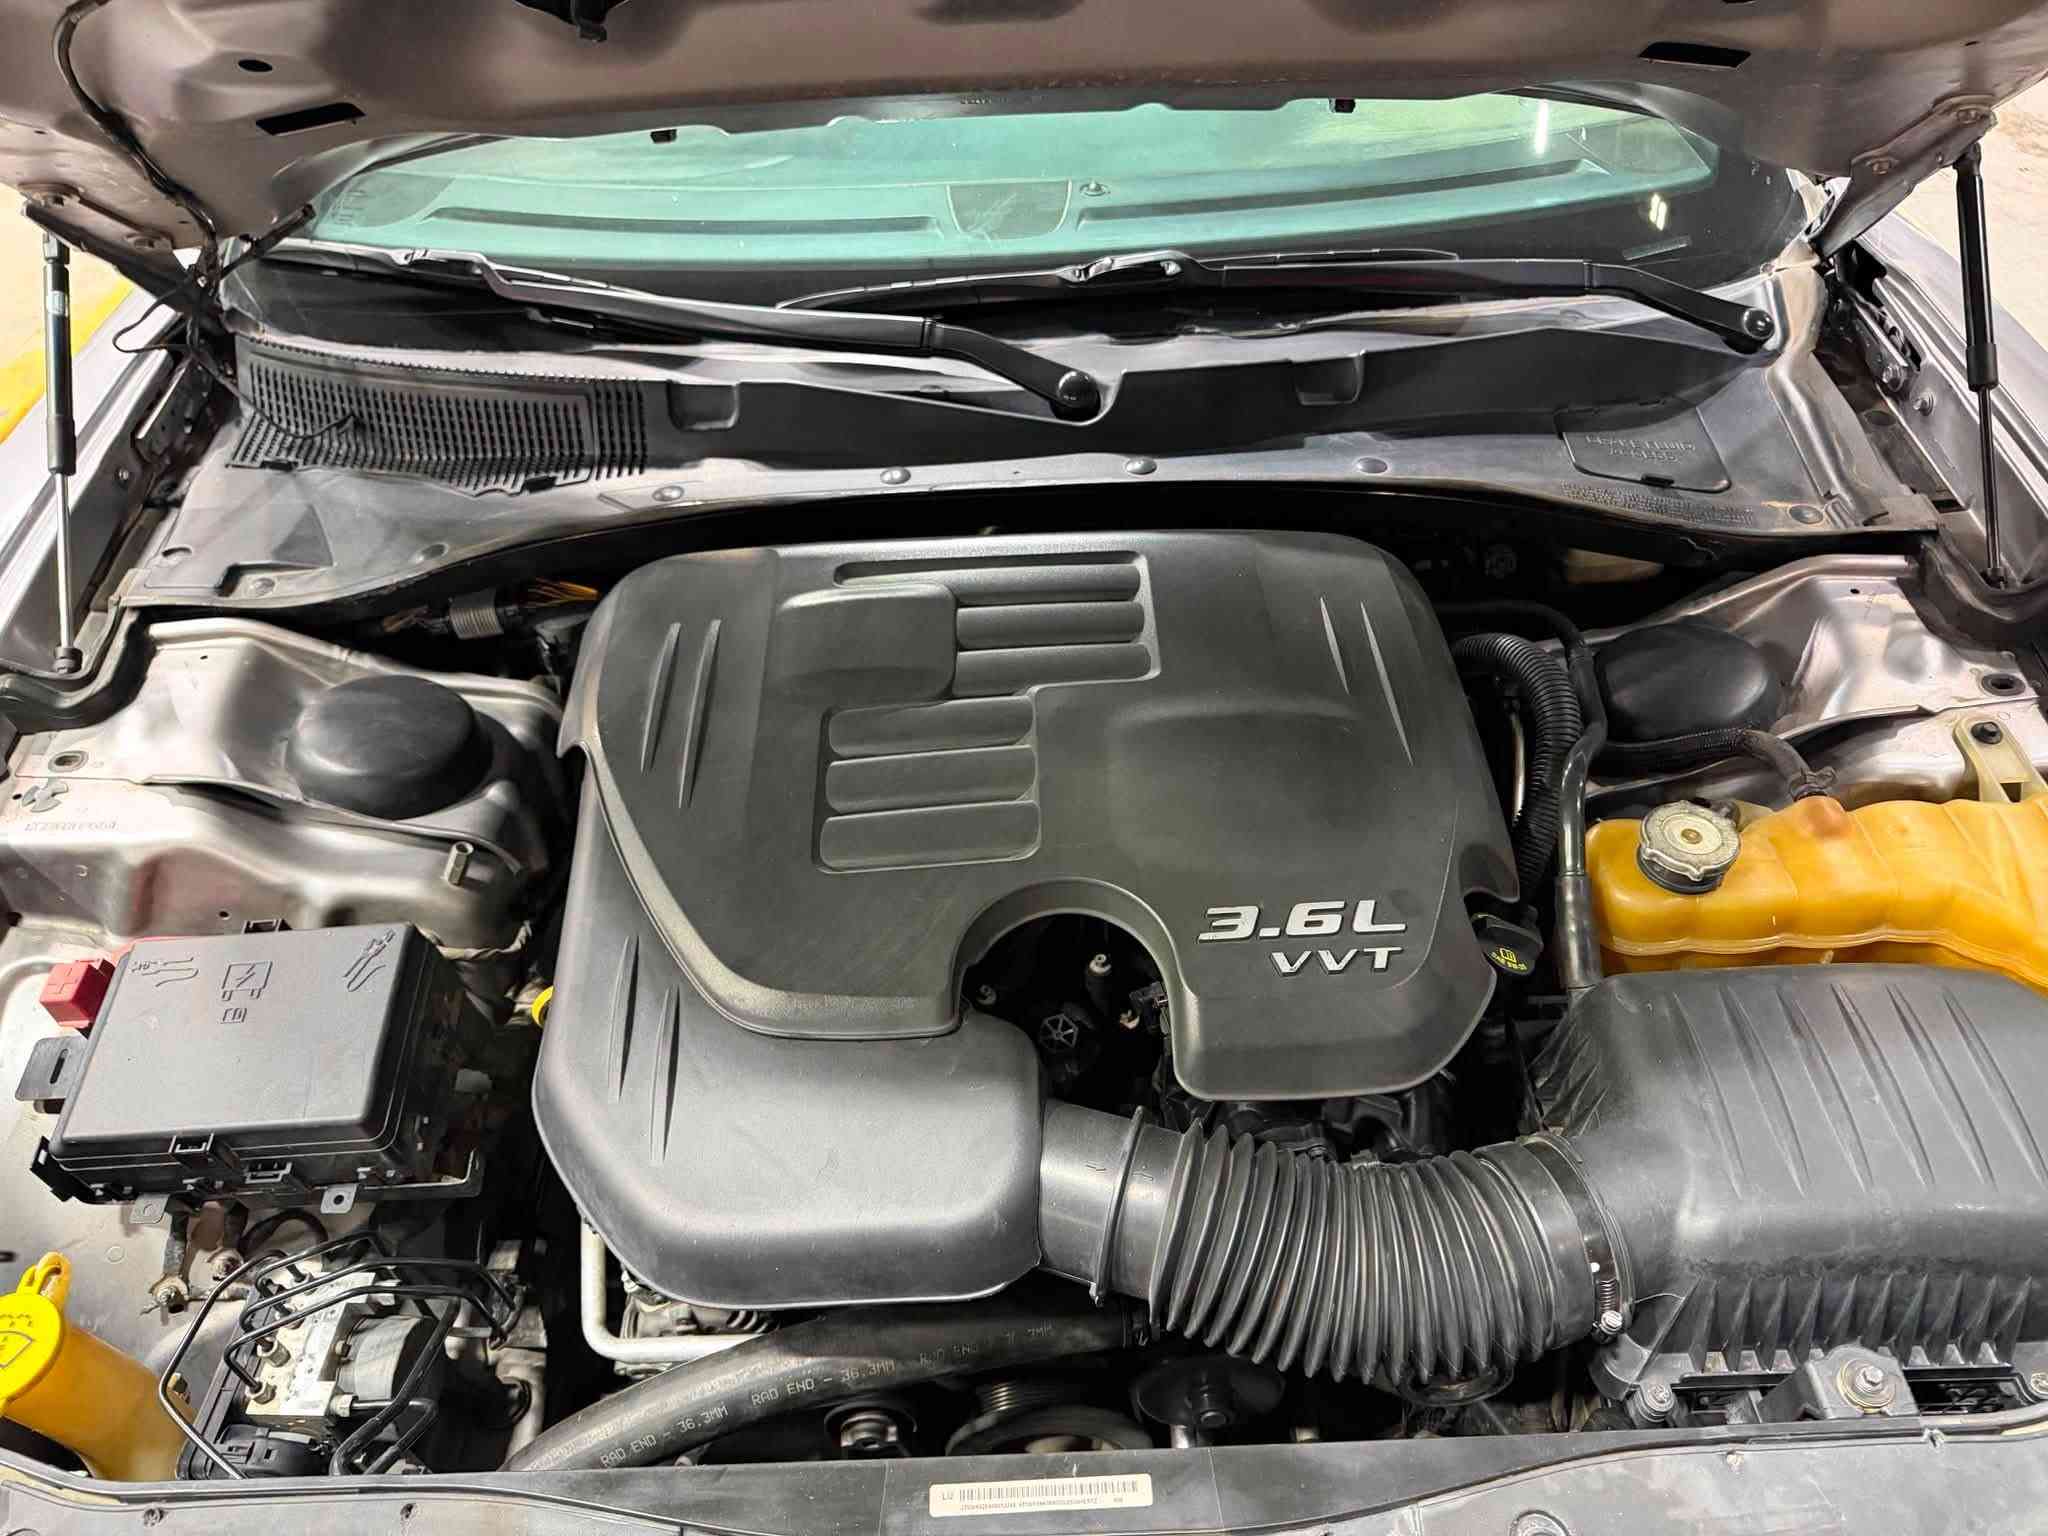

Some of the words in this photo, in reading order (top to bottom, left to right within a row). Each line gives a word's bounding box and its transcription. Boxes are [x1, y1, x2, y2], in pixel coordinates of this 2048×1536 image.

[1199, 900, 1406, 943] 3.6L
[1271, 947, 1404, 976] VVT
[751, 1387, 779, 1406] RAD
[787, 1378, 815, 1395] END
[600, 1447, 626, 1468] RAD
[630, 1434, 657, 1454] END
[676, 1404, 729, 1433] 36.3MM
